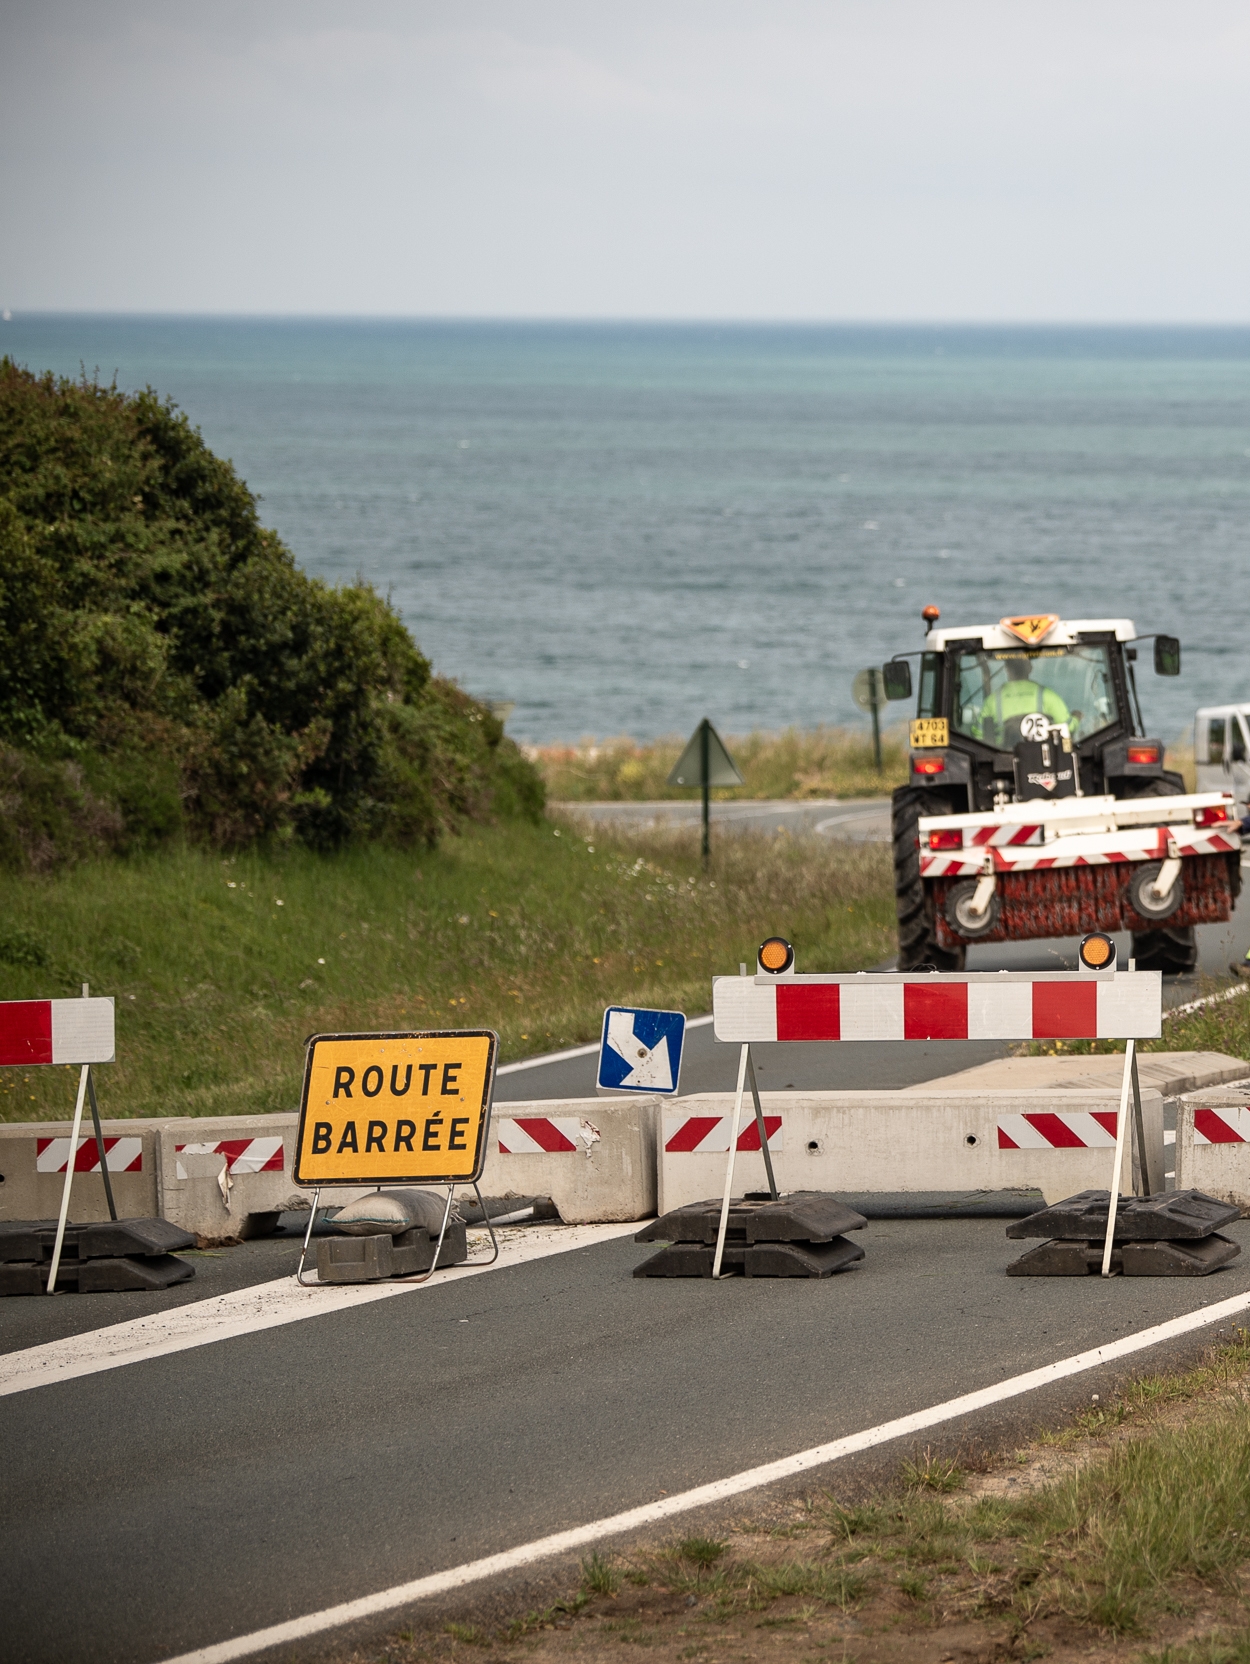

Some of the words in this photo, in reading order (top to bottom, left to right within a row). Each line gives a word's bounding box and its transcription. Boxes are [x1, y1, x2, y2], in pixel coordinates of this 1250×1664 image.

[916, 720, 945, 731] 4703
[931, 733, 945, 745] 64
[332, 1062, 462, 1099] ROUTE
[311, 1110, 470, 1155] BARRÉE
